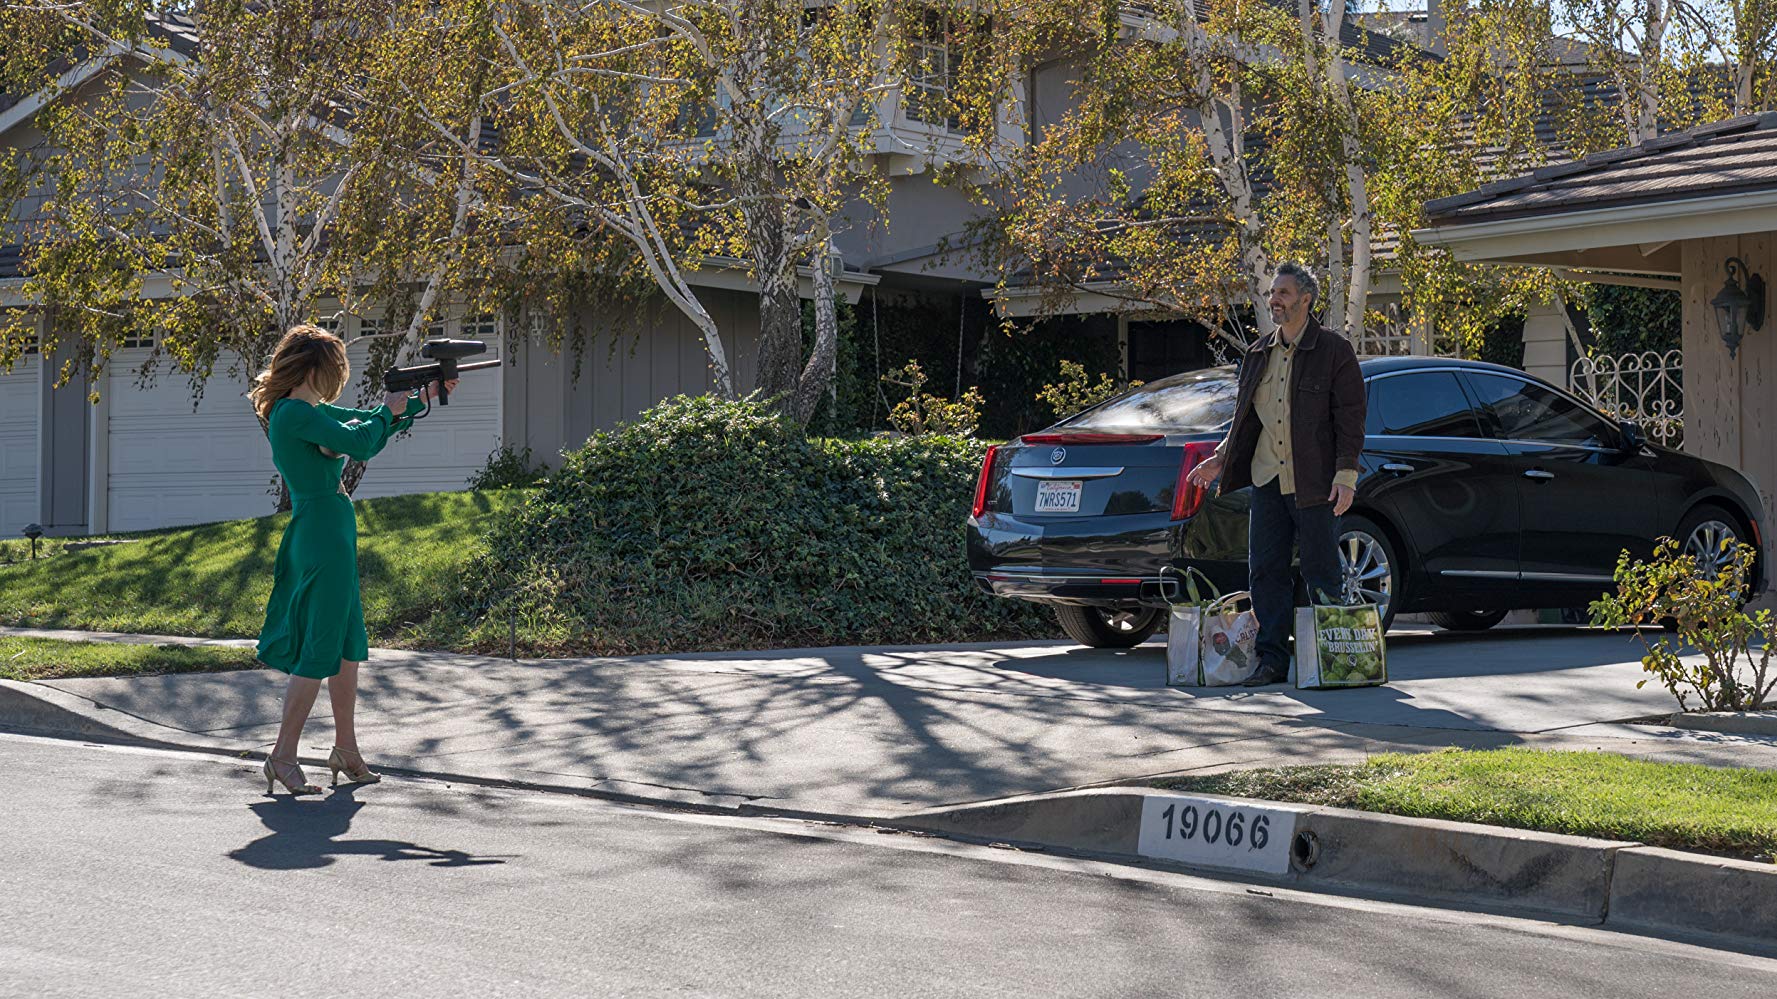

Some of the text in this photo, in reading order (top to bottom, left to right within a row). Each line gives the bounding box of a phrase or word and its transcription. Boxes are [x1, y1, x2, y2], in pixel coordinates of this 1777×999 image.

[1039, 492, 1076, 507] 7WRS571
[1320, 627, 1376, 641] EVERY DAY
[1162, 803, 1270, 850] 19066
